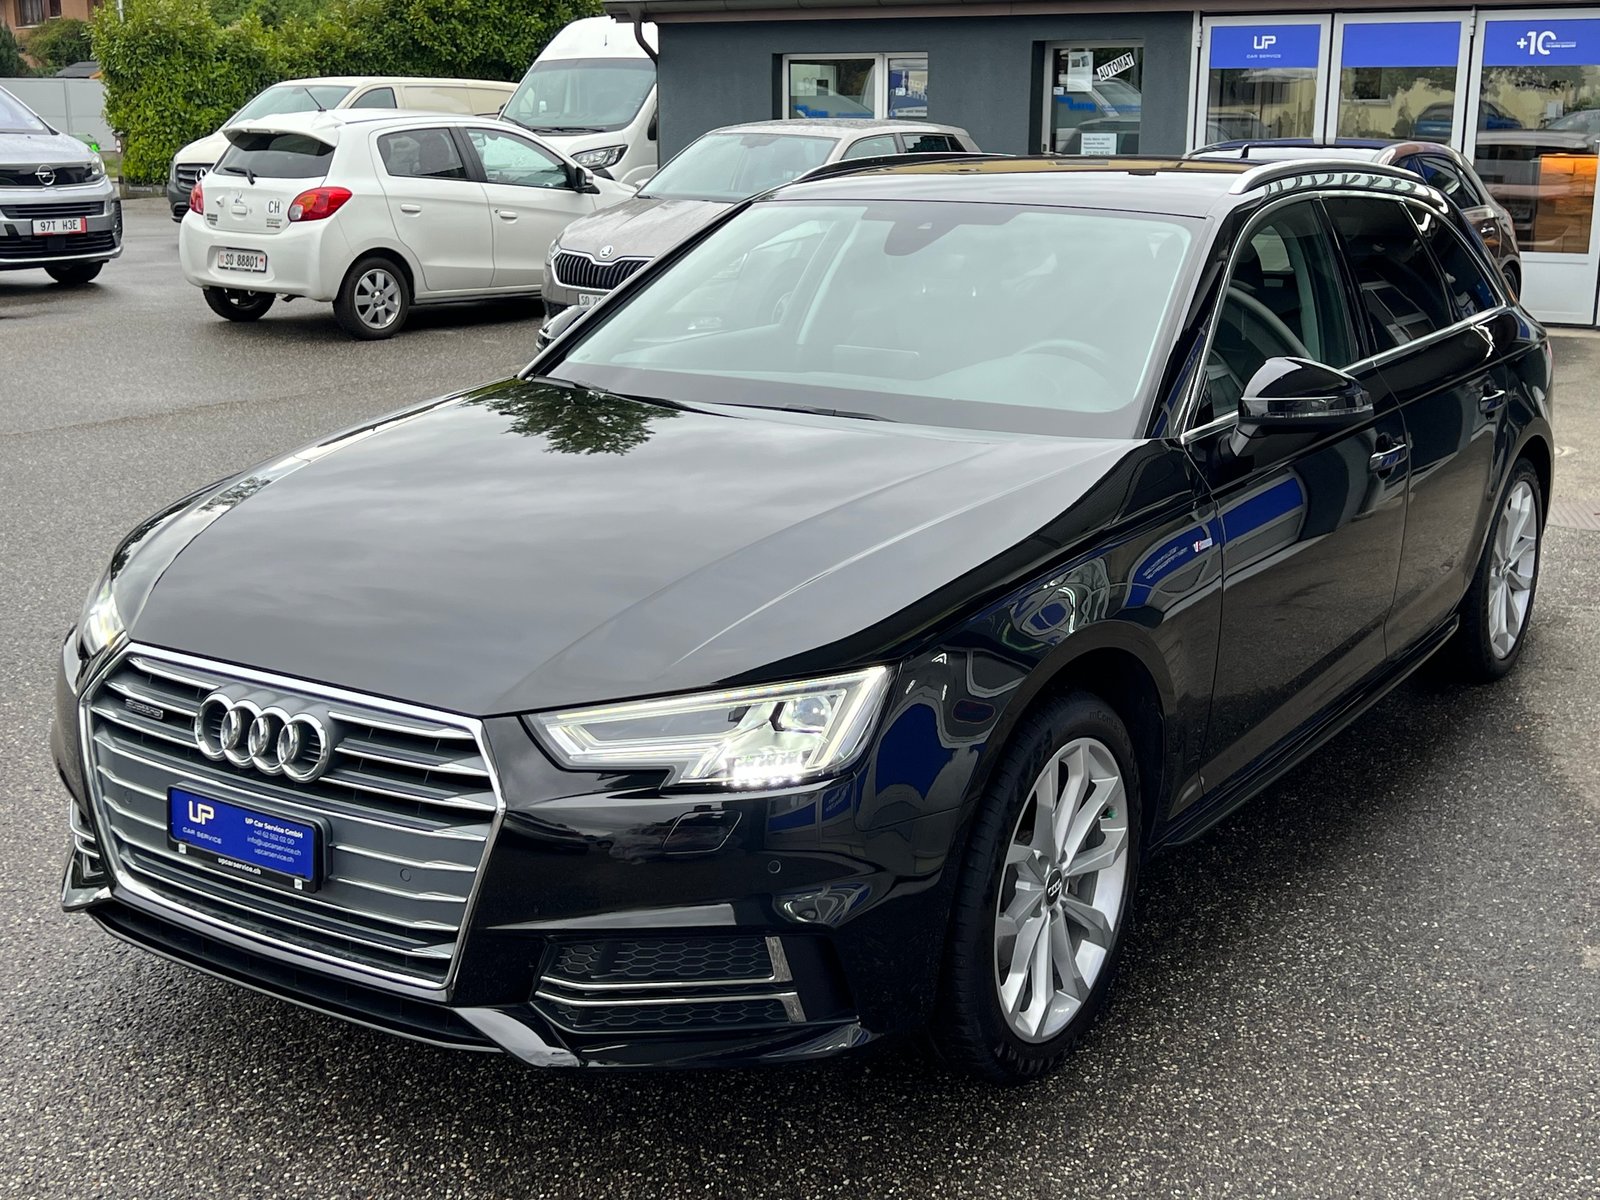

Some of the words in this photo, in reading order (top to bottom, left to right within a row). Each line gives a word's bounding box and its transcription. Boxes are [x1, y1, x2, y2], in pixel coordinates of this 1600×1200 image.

[1253, 35, 1276, 49] UP
[1099, 54, 1134, 79] AUTOMAT
[268, 200, 280, 214] CH
[40, 221, 56, 232] 97T
[62, 220, 78, 231] H3E
[225, 253, 234, 266] SO
[236, 254, 258, 268] 88801
[593, 296, 603, 305] 2
[188, 800, 214, 825] UP
[182, 826, 195, 835] CAR
[196, 831, 222, 844] SERVICE
[245, 817, 253, 825] UP
[254, 820, 264, 828] Car
[264, 823, 284, 834] Service
[285, 828, 303, 839] GmbH
[218, 857, 261, 875] upcarservice.ch
